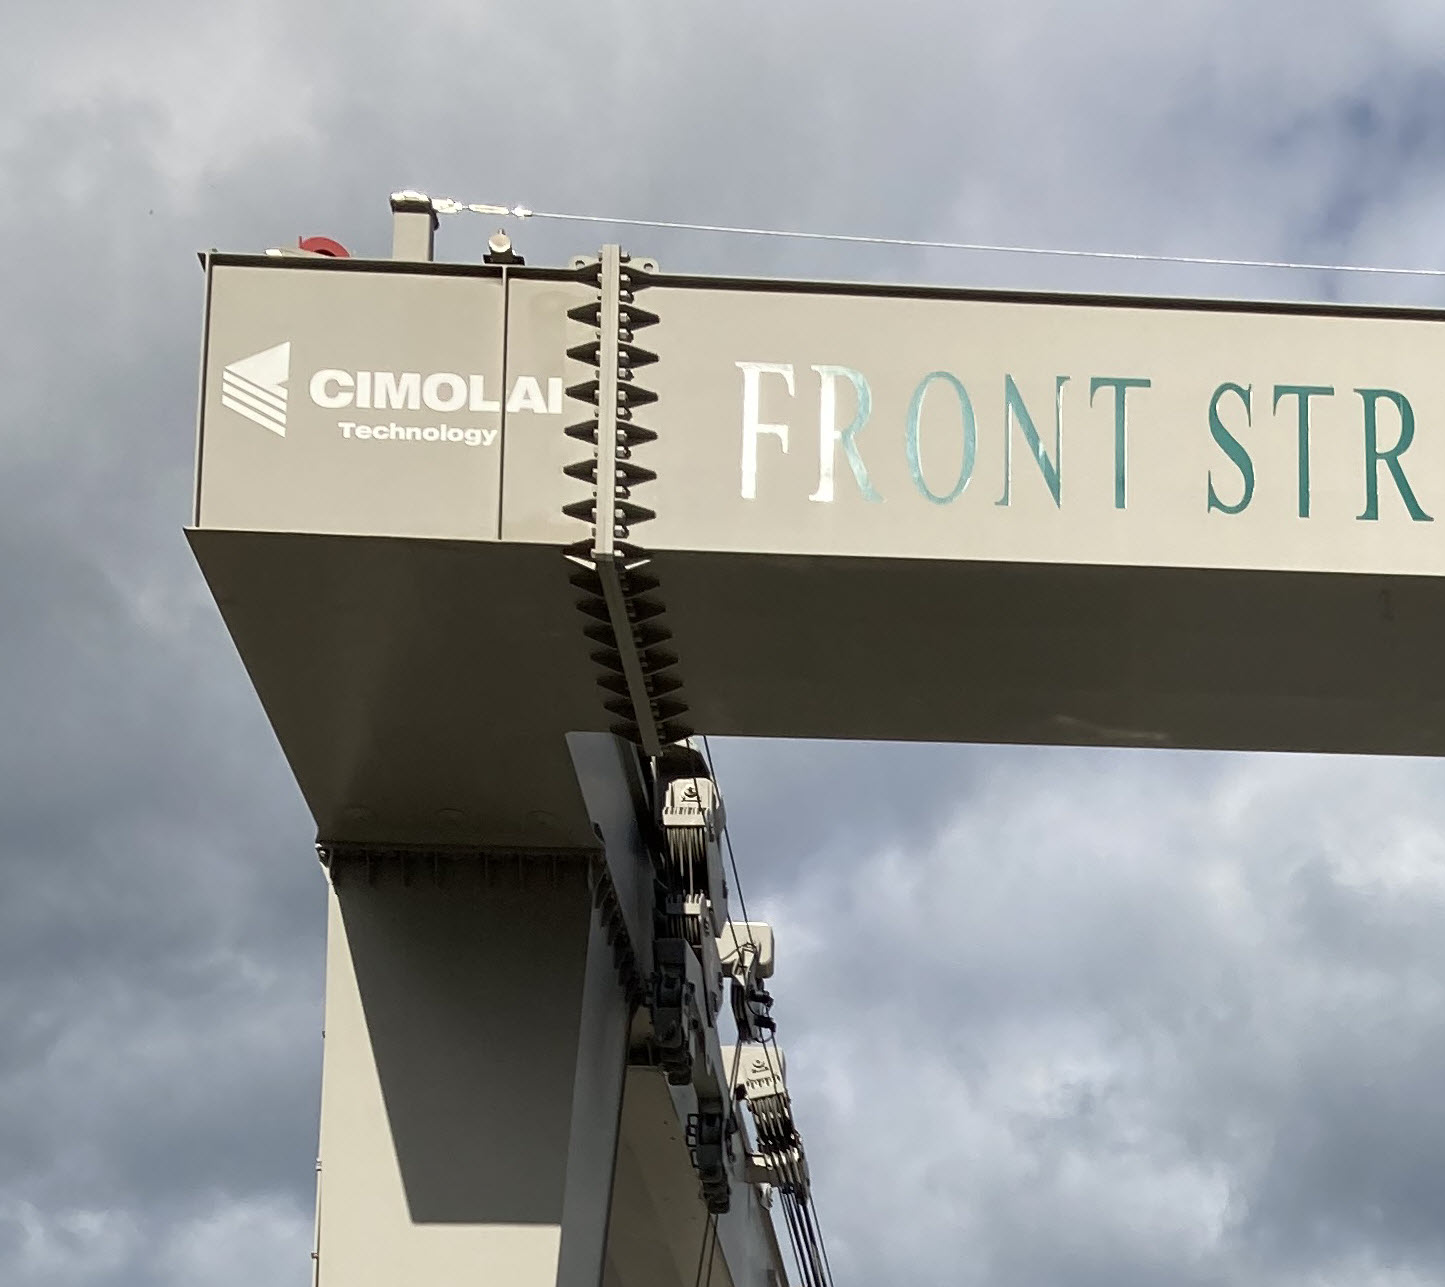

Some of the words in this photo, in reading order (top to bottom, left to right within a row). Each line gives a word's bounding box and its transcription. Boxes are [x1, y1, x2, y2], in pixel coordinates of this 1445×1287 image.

[309, 368, 562, 415] CIMOLAI
[337, 422, 498, 447] Technology
[733, 360, 1153, 511] FRONT
